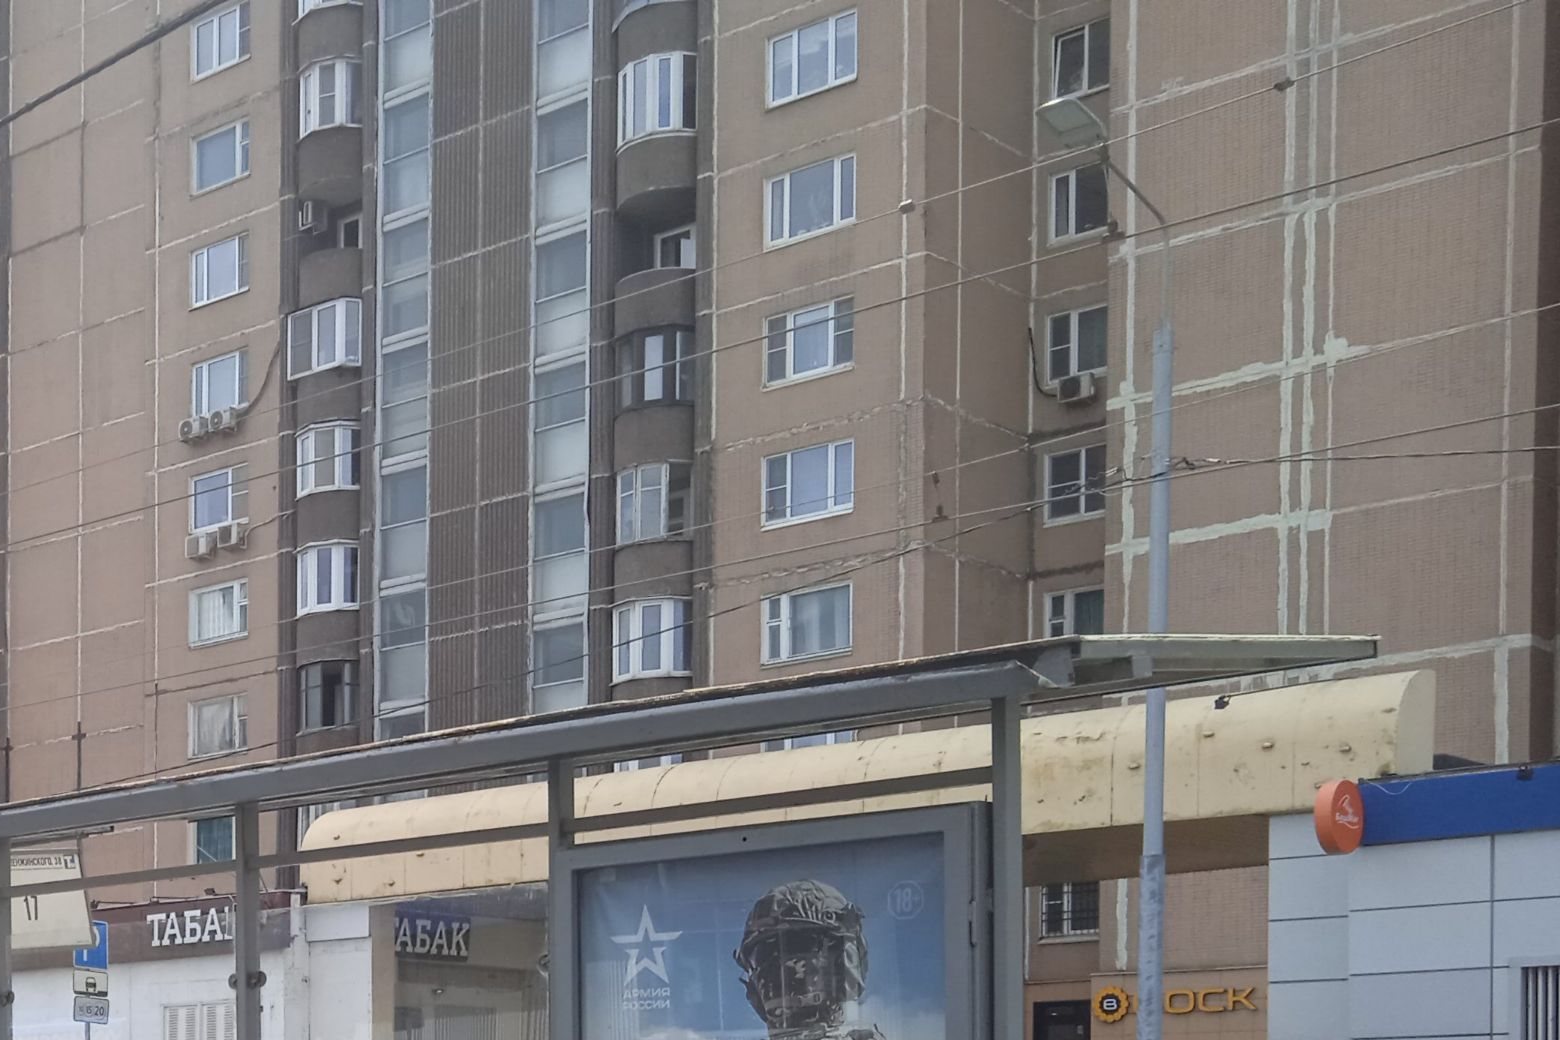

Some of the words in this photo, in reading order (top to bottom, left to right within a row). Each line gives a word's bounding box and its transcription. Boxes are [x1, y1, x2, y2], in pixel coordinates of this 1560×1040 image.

[894, 887, 920, 913] 18+
[23, 896, 38, 920] 17
[623, 987, 671, 999] АРМИЯ
[94, 1005, 105, 1016] 20
[623, 1000, 671, 1010] РОССИИ
